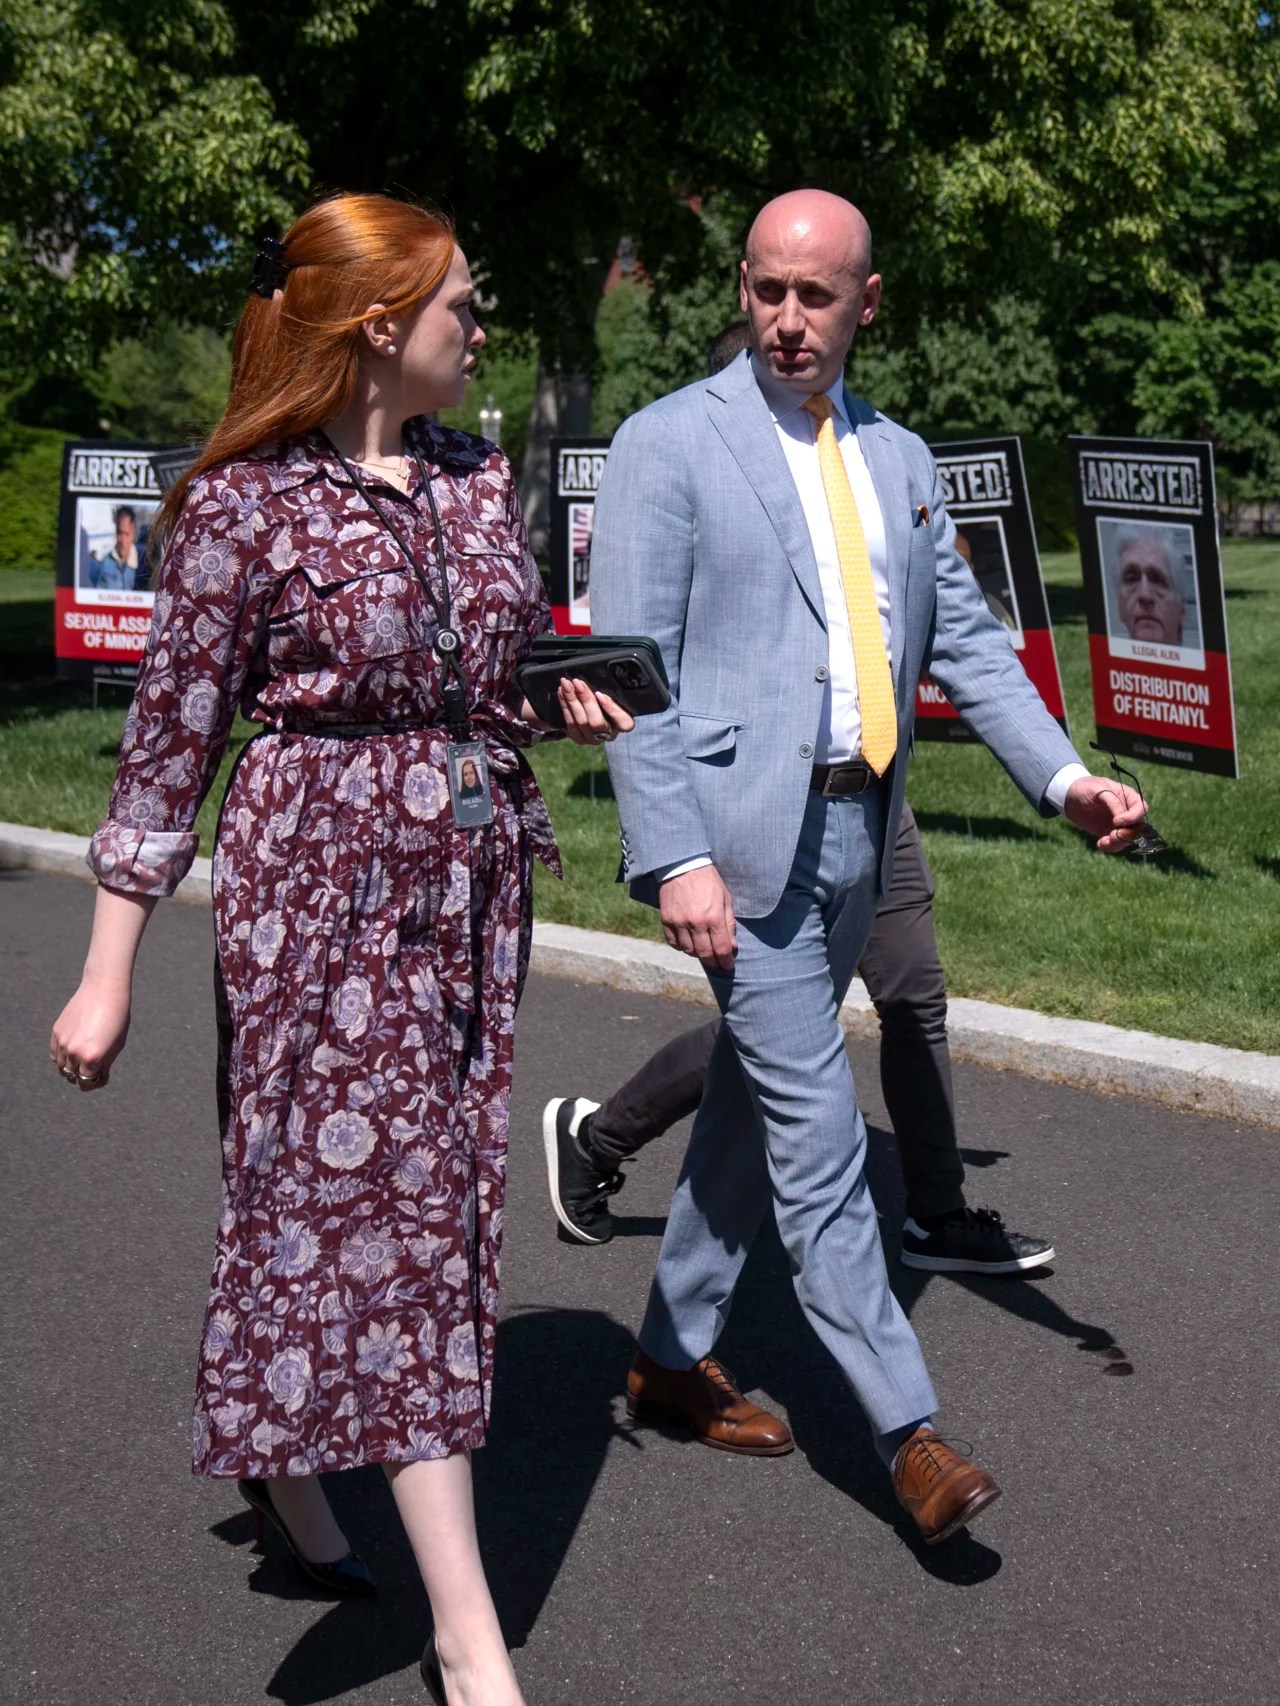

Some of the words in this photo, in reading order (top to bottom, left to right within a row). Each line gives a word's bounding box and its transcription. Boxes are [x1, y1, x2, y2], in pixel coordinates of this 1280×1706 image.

[1086, 461, 1197, 505] ARRESTED
[64, 612, 117, 631] SEXUAL
[83, 631, 103, 648] OF
[1132, 645, 1158, 657] ILLEGAL
[1160, 650, 1181, 660] ALIEN
[1109, 669, 1210, 706] DISTRIBUTION
[1113, 694, 1132, 714] OF
[1134, 697, 1210, 730] FENTANYL
